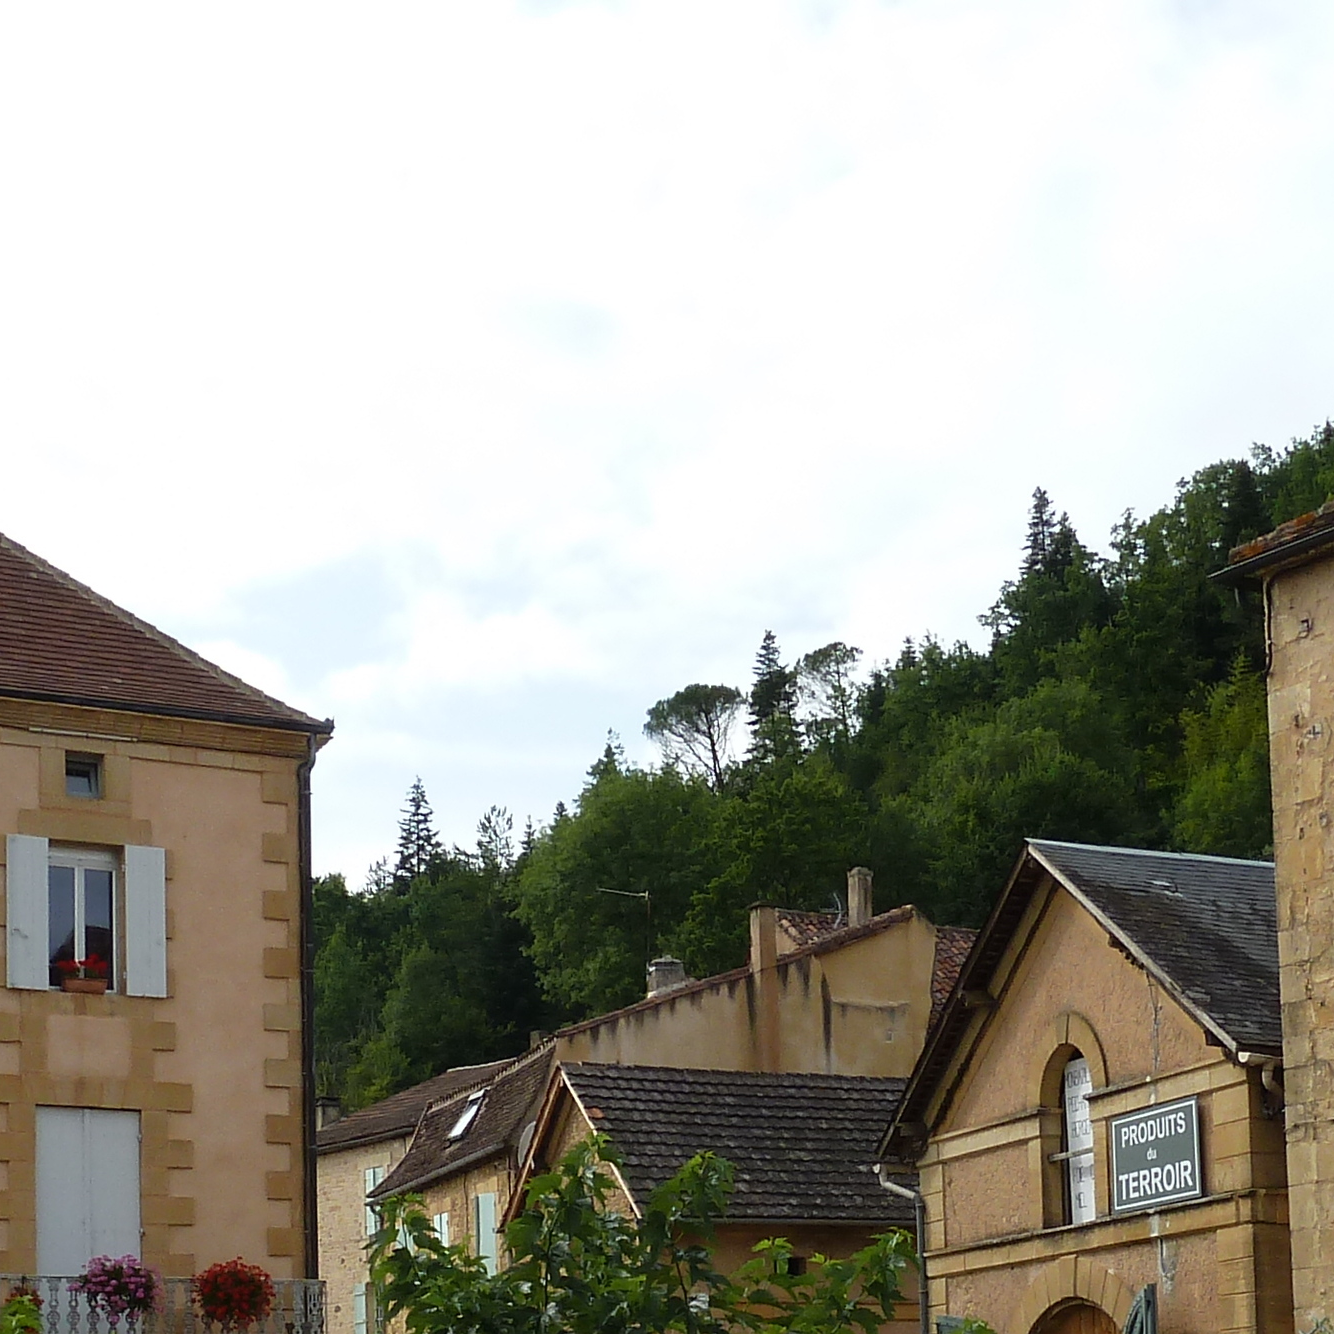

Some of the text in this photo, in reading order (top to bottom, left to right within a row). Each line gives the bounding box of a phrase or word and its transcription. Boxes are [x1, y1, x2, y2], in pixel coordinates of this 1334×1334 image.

[1121, 1112, 1186, 1148] PRODUITS
[1146, 1147, 1157, 1161] du
[1119, 1160, 1194, 1200] TERROIR
